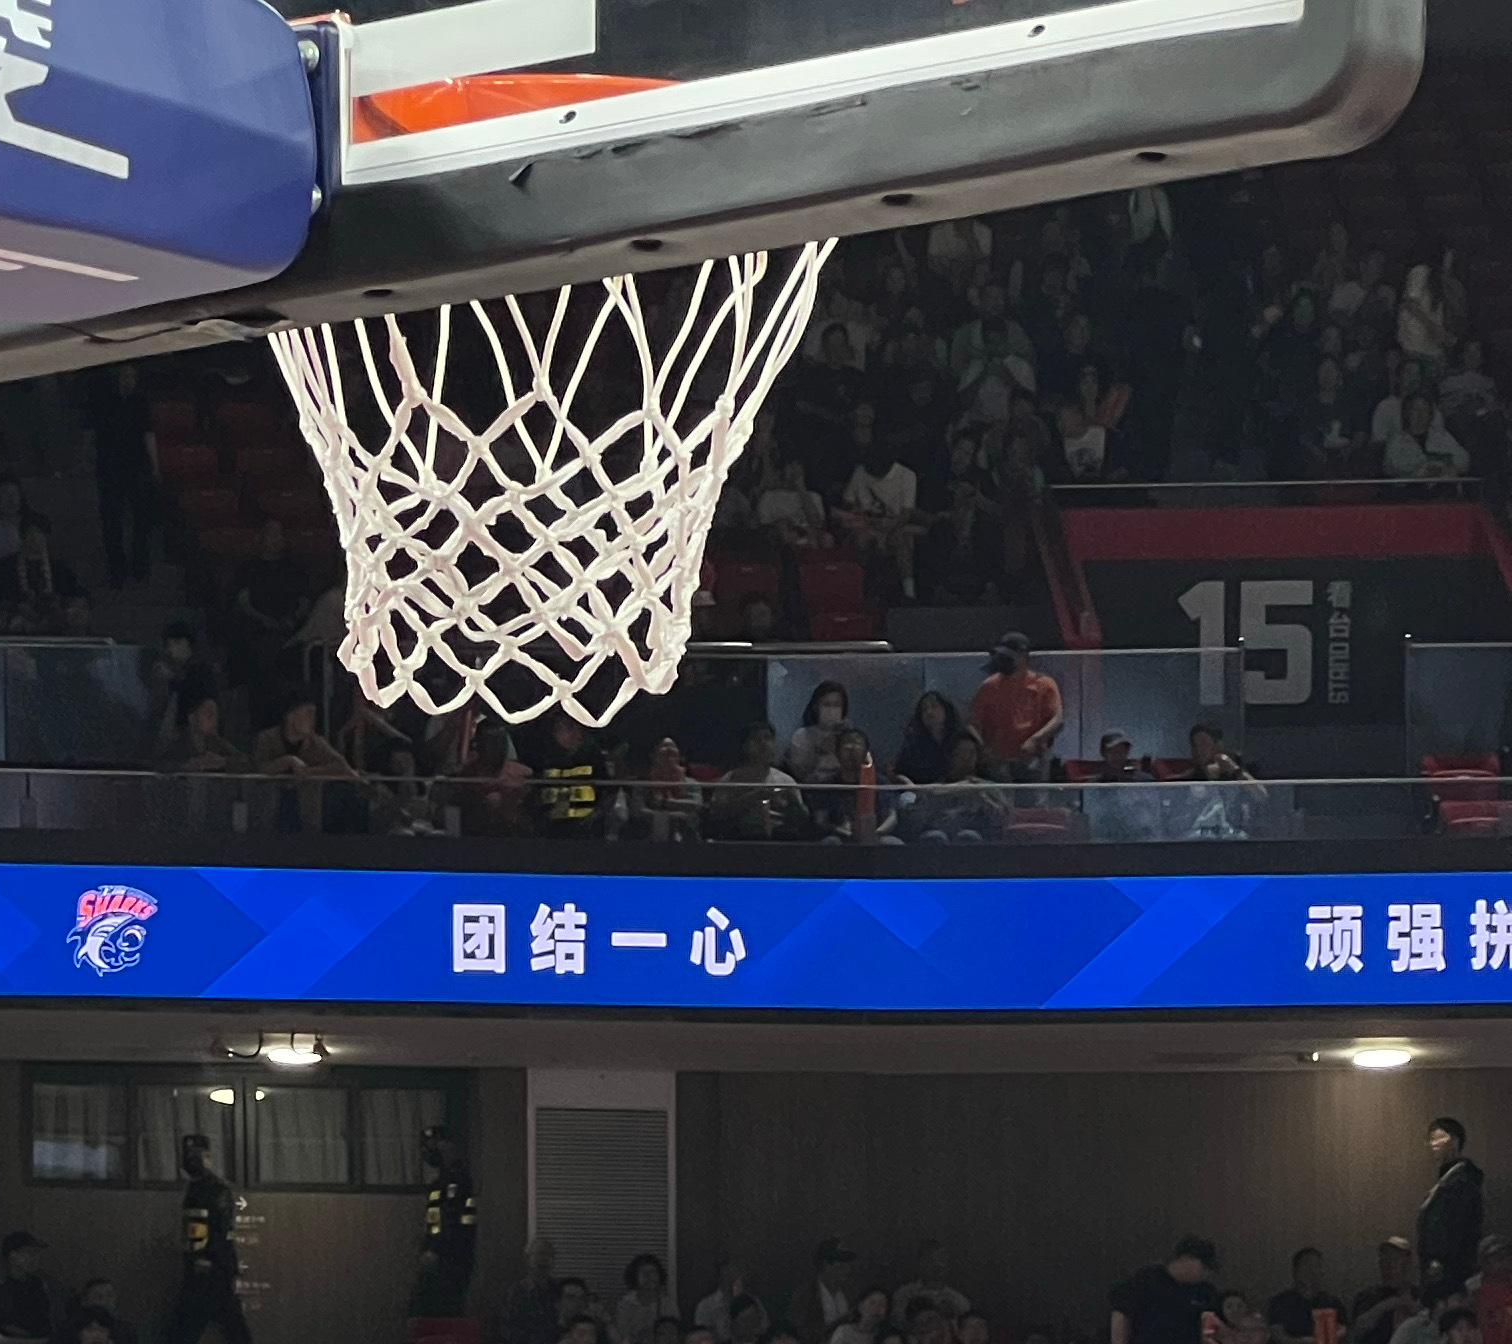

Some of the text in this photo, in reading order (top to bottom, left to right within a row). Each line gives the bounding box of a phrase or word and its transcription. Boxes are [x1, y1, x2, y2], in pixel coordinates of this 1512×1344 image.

[1177, 580, 1313, 705] 15
[451, 902, 747, 977] 团结一心
[1304, 899, 1512, 974] 顽强拼
